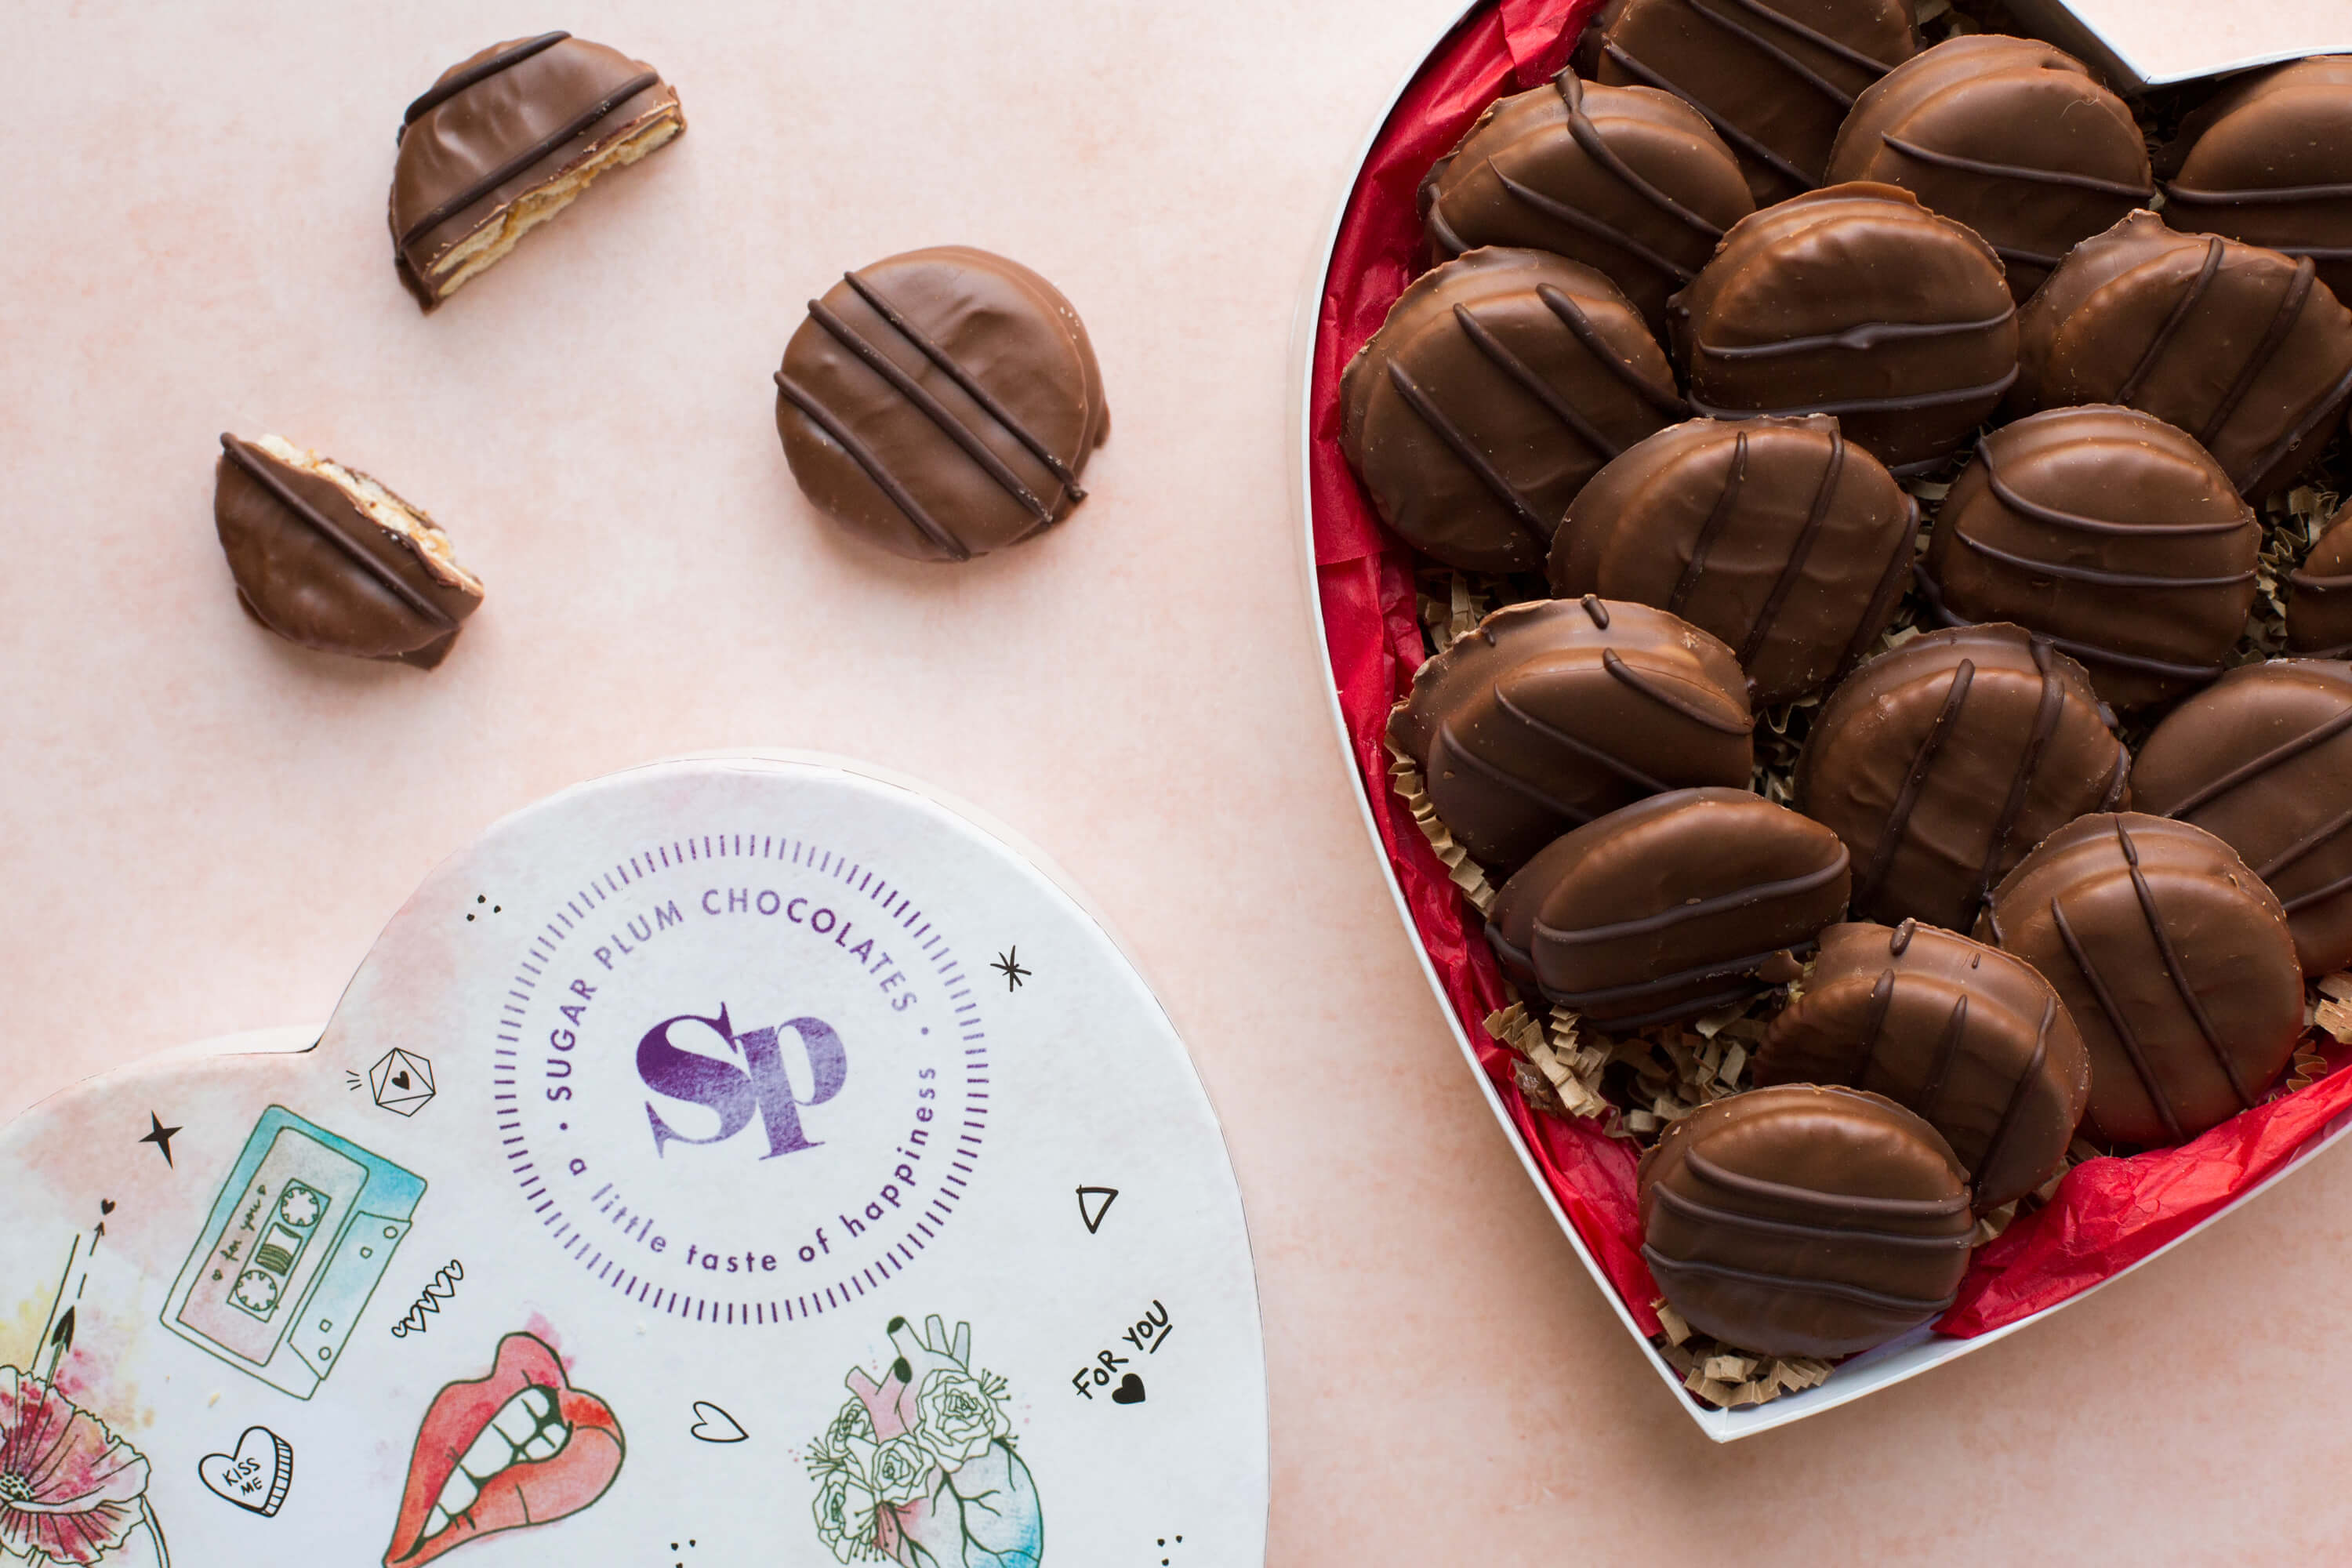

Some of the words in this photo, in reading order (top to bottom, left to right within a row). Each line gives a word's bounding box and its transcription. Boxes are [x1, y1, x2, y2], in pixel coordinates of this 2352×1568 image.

[545, 978, 597, 1102] SUGAR
[593, 899, 684, 971] PLUM
[701, 887, 918, 1013] CHOCOLATES
[568, 1157, 588, 1177] a
[590, 1182, 667, 1254] little
[686, 1243, 778, 1274] taste
[797, 1226, 830, 1263] of
[839, 1066, 937, 1239] happiness
[240, 1198, 261, 1231] you
[1072, 1349, 1130, 1400] FOR
[1121, 1299, 1169, 1351] YOU
[222, 1457, 261, 1486] KISS
[240, 1476, 263, 1497] ME
